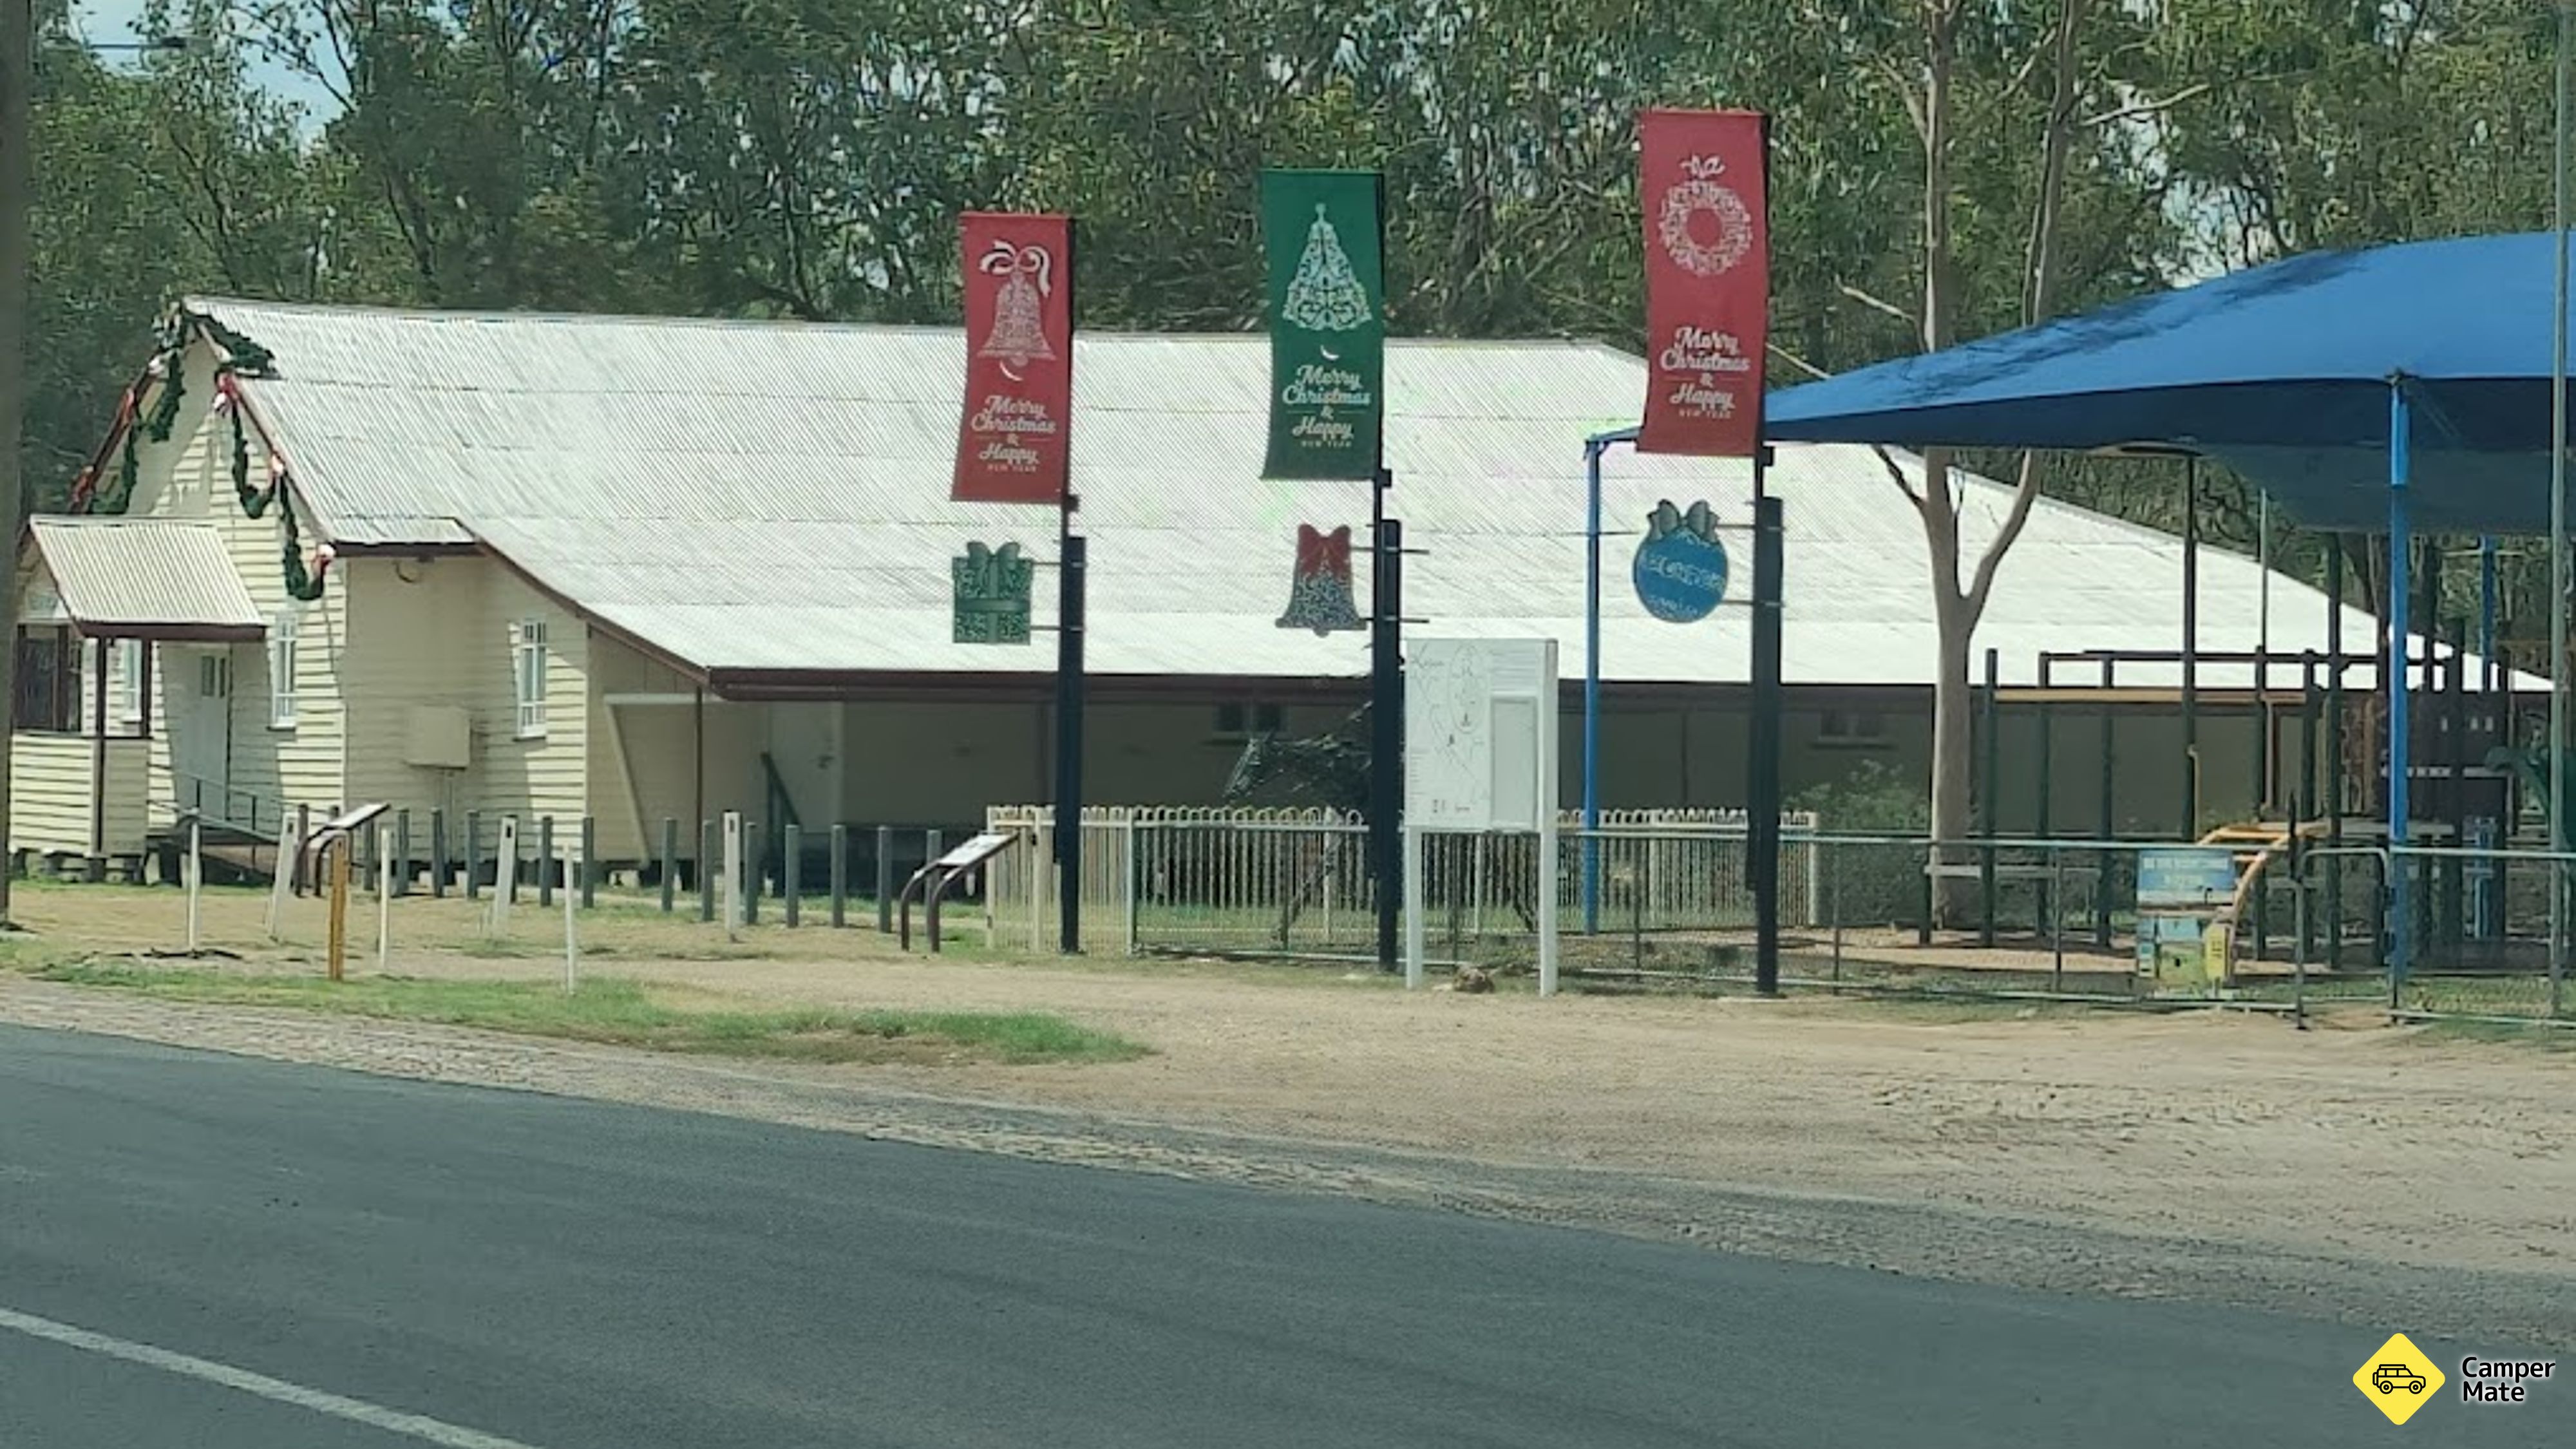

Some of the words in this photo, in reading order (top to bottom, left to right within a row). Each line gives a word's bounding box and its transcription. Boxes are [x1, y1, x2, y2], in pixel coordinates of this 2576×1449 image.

[1674, 327, 1739, 354] Merry
[1661, 346, 1750, 369] Christmas
[1295, 365, 1362, 389] Merry
[1700, 373, 1712, 387] &
[1282, 384, 1370, 404] Christmas
[1669, 383, 1735, 410] Happy
[983, 395, 1048, 419] Merry
[1321, 405, 1332, 419] &
[1679, 408, 1702, 417] NEW
[1707, 410, 1732, 419] YEAR
[972, 412, 1056, 433] Christmas
[1292, 416, 1353, 440] Happy
[1007, 433, 1019, 446] &
[979, 443, 1039, 464] Happy
